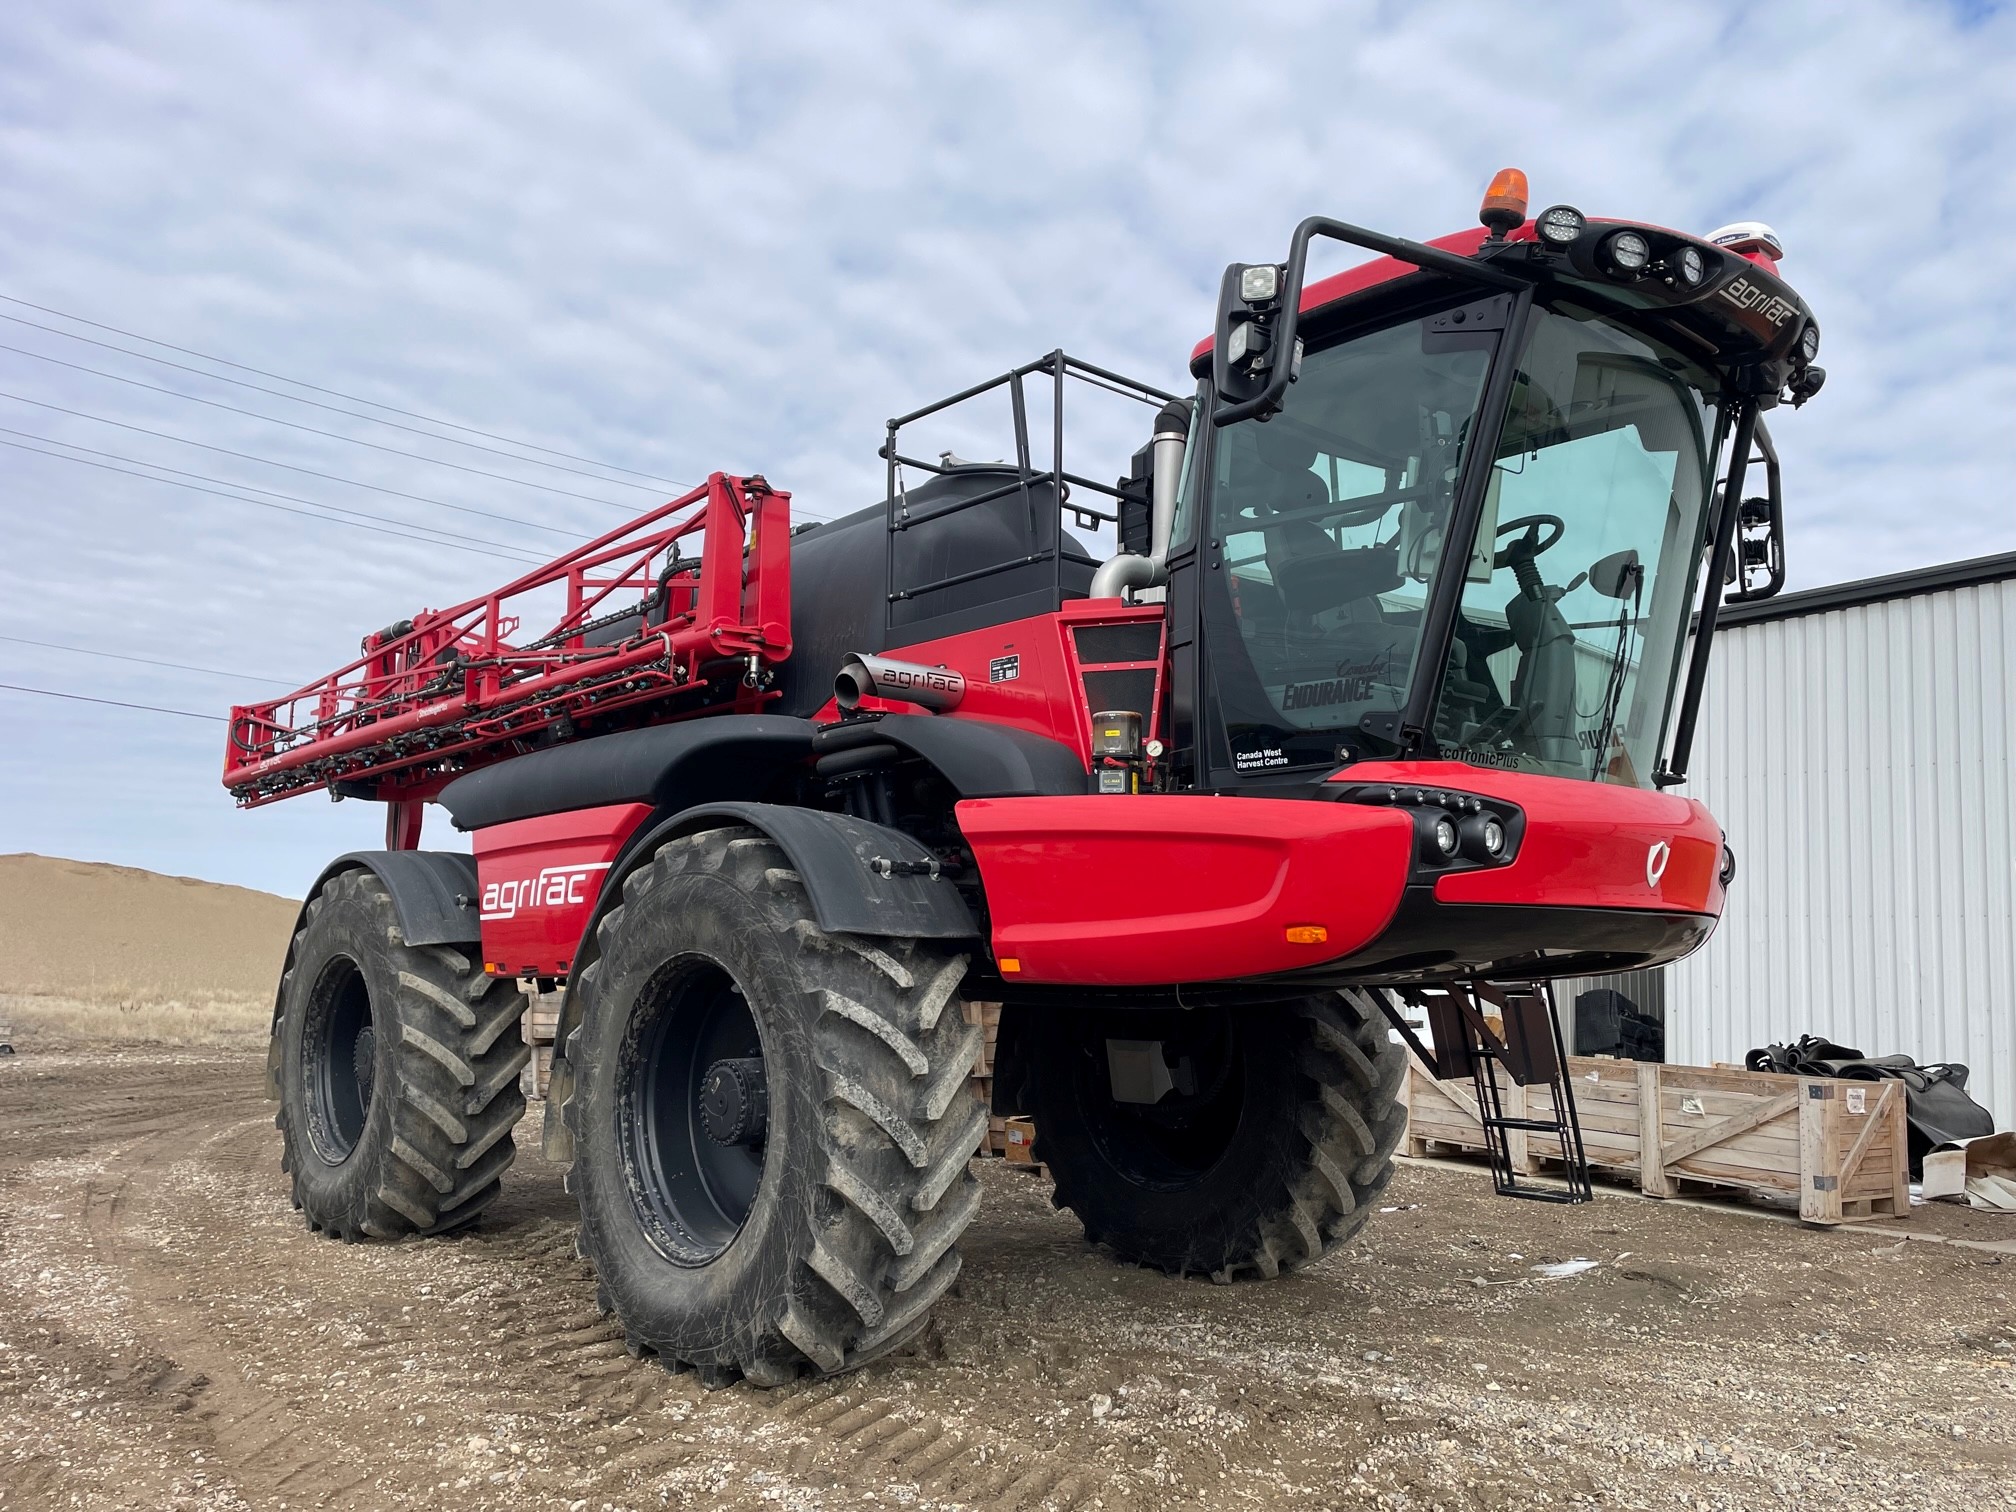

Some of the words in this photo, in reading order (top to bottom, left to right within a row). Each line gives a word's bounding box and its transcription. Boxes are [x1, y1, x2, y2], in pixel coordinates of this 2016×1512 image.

[1719, 277, 1800, 327] agrifac
[877, 669, 962, 692] agrifac
[1282, 675, 1377, 711] ENDURANCE
[1236, 750, 1263, 761] Canada
[1263, 748, 1282, 758] West
[1237, 759, 1264, 769] Harvest
[1264, 757, 1288, 766] Centre
[480, 862, 613, 921] agrifac
